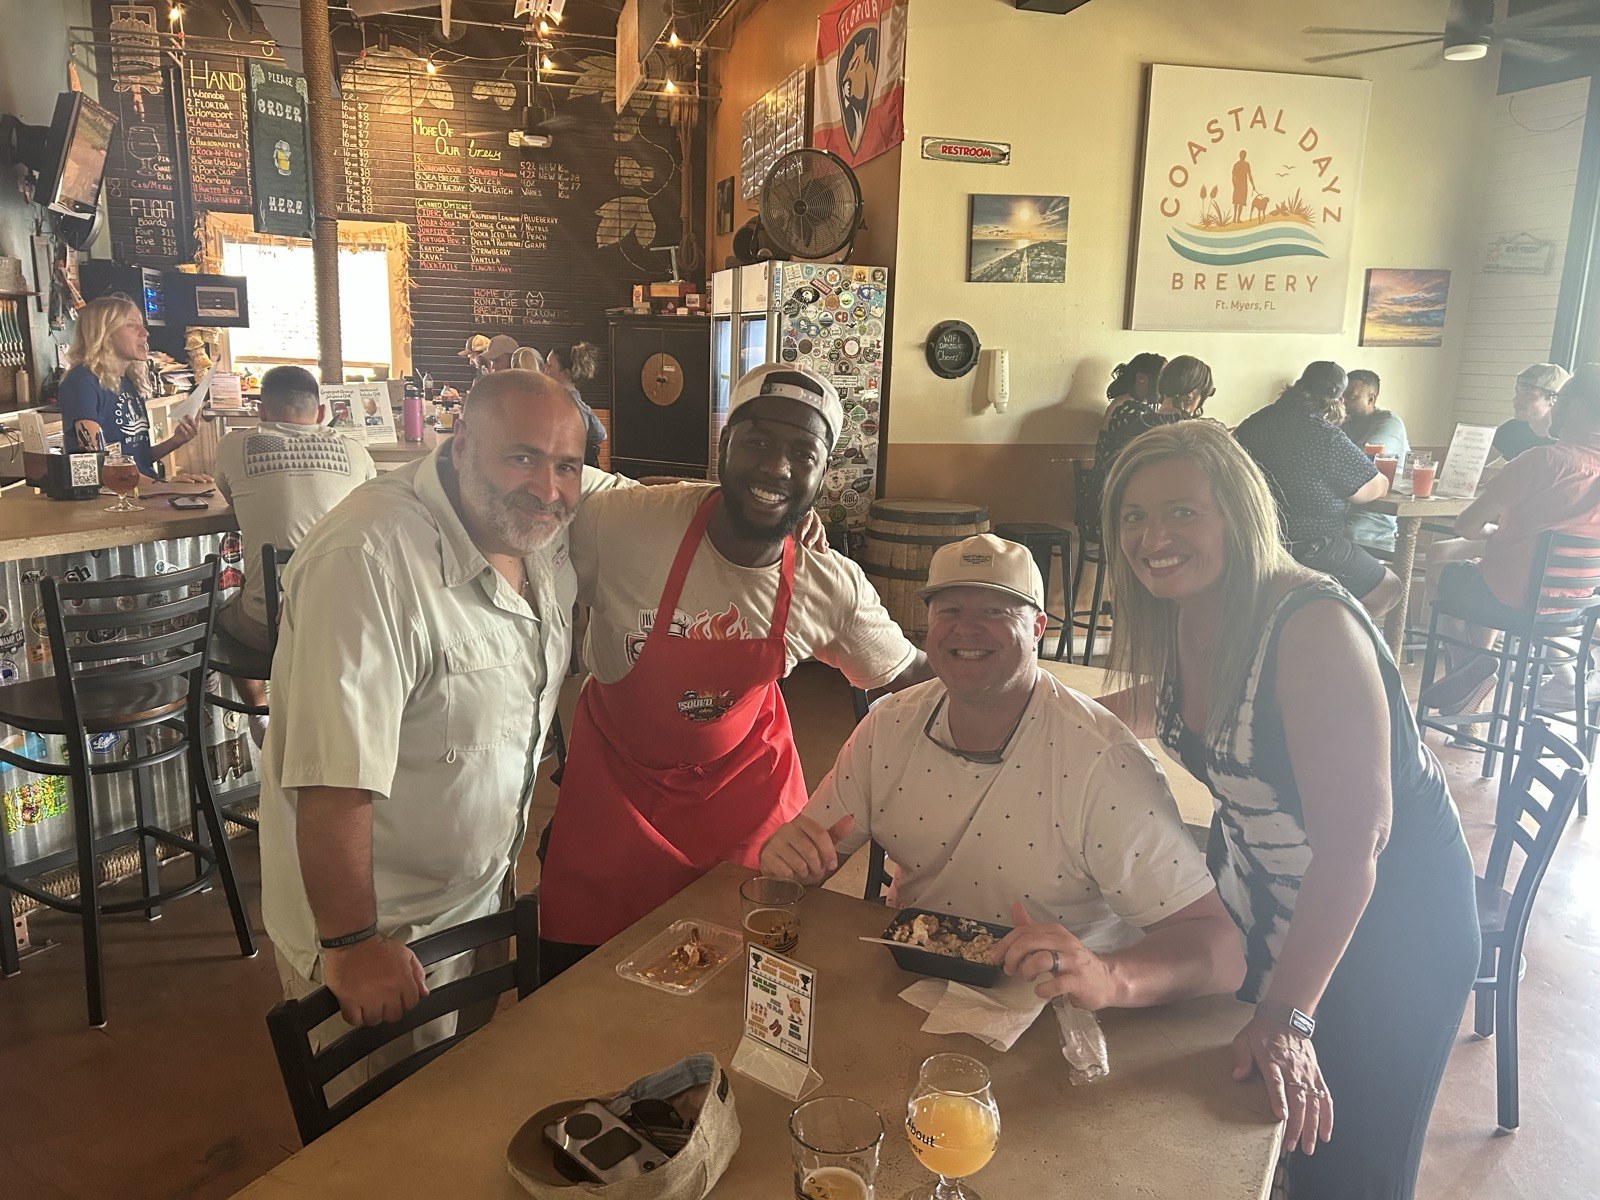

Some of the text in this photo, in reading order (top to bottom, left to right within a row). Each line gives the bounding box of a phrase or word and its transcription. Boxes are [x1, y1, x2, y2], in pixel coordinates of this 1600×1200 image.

[841, 0, 878, 44] FLORIDA
[268, 72, 294, 87] PLEASE
[195, 98, 230, 110] FLORIDA
[257, 98, 302, 122] ORDER
[195, 108, 234, 120] Homeport
[413, 116, 454, 137] MORE OF
[436, 136, 460, 156] OUR
[941, 145, 992, 158] RESTROOM
[1160, 105, 1342, 223] COASTAL DAYZ
[468, 176, 502, 185] SELTZER
[469, 184, 492, 194] SMALL
[493, 186, 514, 195] BATCH
[130, 198, 175, 219] FLIGHT
[268, 196, 303, 215] HERE
[138, 218, 167, 228] Boards
[135, 227, 154, 236] Four
[526, 232, 547, 241] PEACH
[136, 236, 155, 246] Five
[136, 246, 152, 254] Six
[471, 246, 511, 256] STRAWBERRY
[471, 255, 500, 264] VANILLA
[1171, 272, 1319, 292] BREWERY
[474, 288, 499, 298] HOME
[474, 298, 518, 306] KONA THE
[1215, 300, 1276, 312] Ft. Myers, FL
[474, 306, 512, 316] BREWERY
[474, 316, 513, 324] KITTEN
[906, 1118, 934, 1148] About
